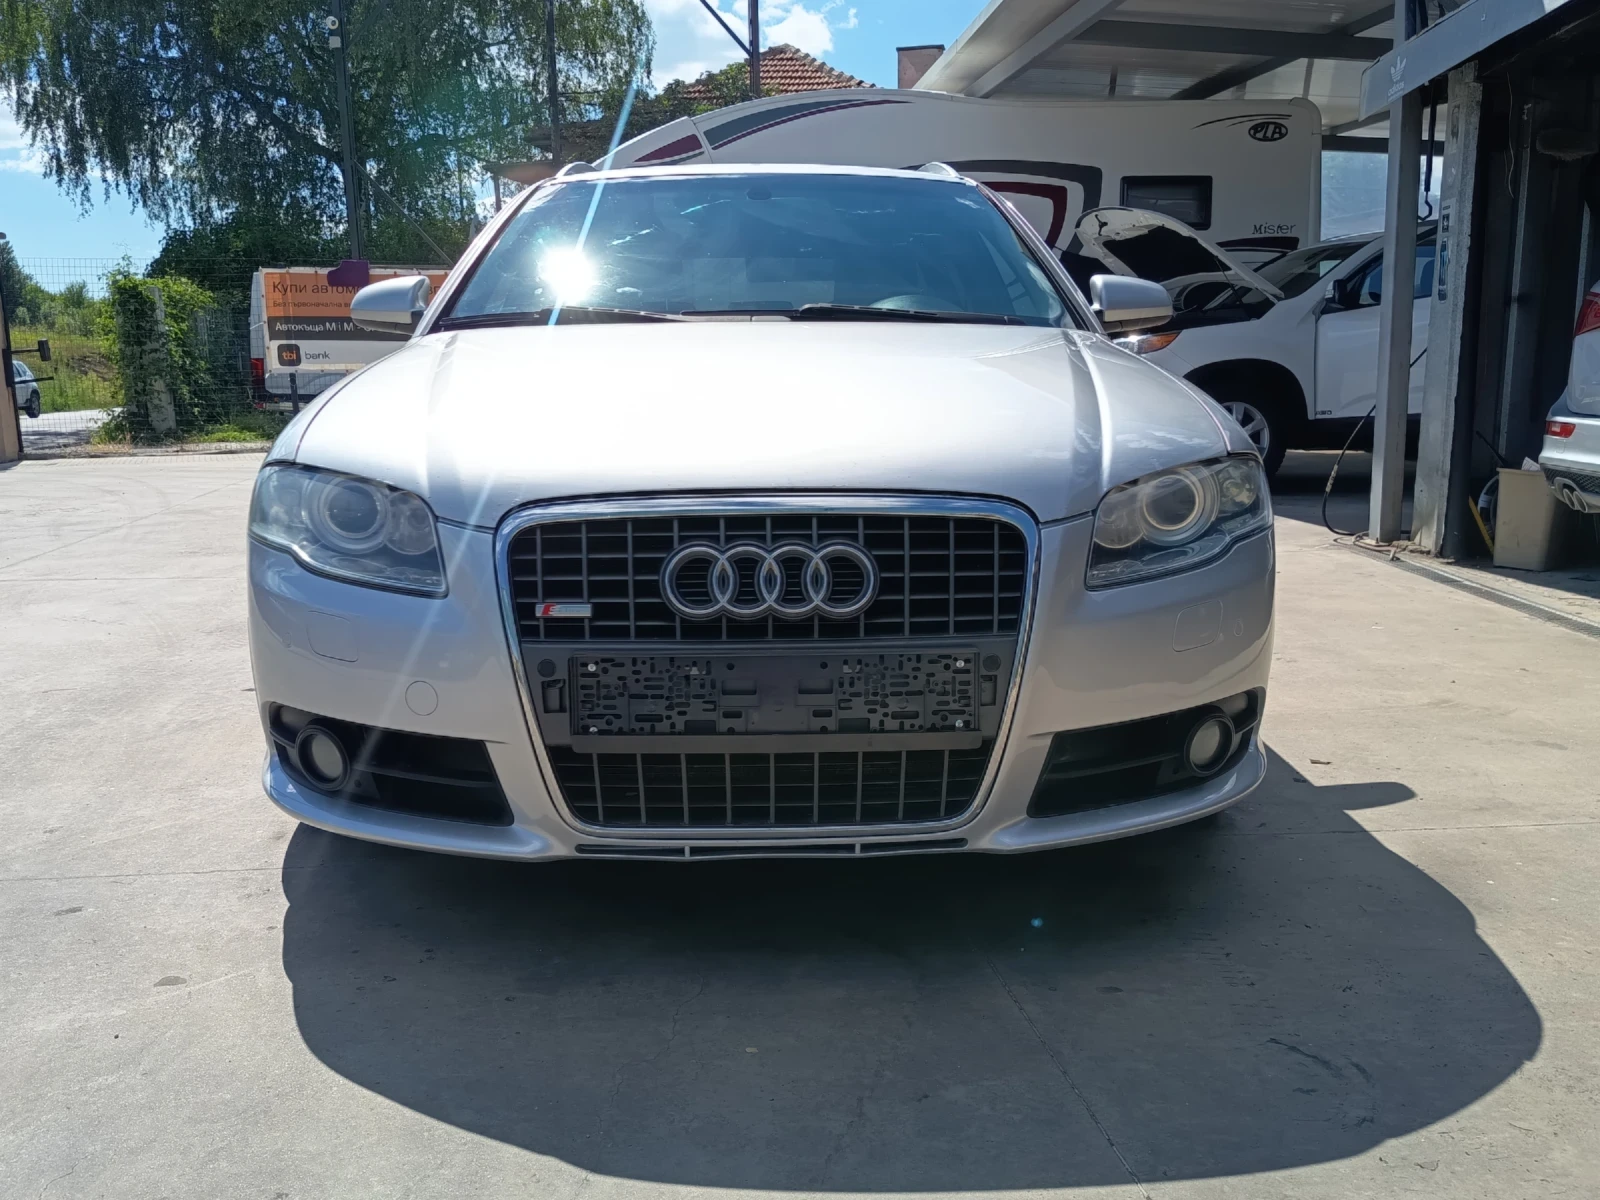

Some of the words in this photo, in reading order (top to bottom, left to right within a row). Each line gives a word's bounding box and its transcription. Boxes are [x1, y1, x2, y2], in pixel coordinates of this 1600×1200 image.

[1251, 122, 1286, 139] PLA
[1252, 222, 1297, 235] Mister
[272, 281, 308, 296] Купи
[272, 300, 287, 308] Без
[275, 321, 324, 332] Автокъща
[281, 350, 297, 360] tbi
[304, 350, 331, 360] bank
